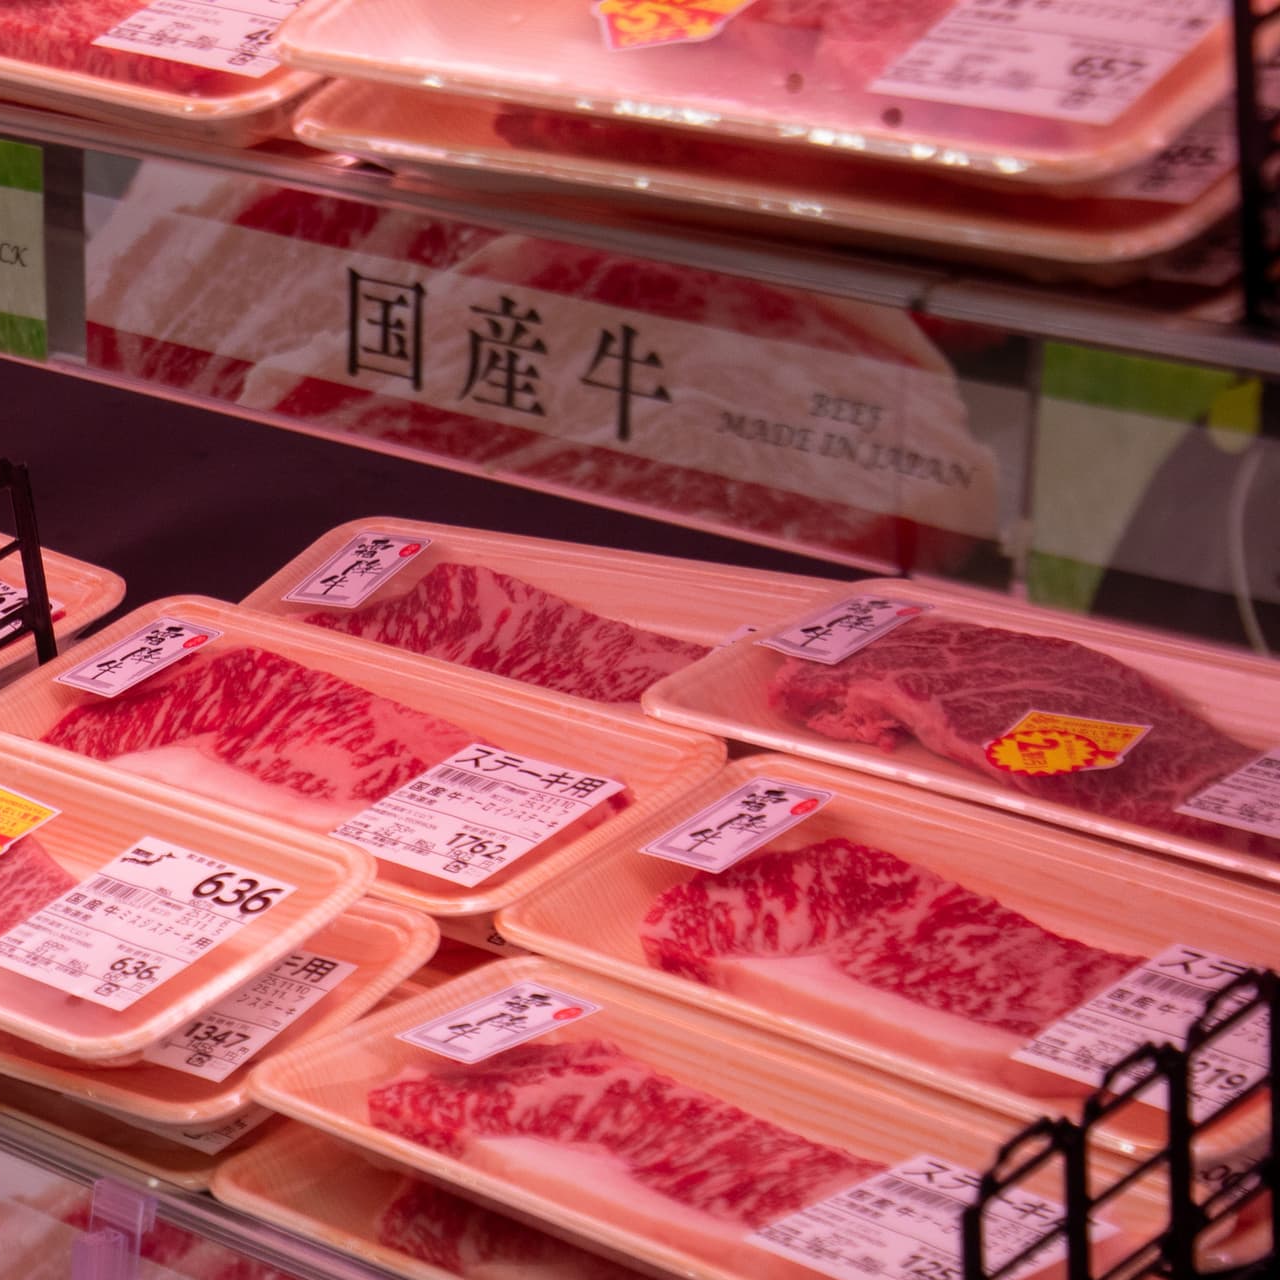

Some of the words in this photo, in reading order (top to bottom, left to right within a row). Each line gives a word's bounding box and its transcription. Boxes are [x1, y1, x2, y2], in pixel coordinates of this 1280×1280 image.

[347, 266, 672, 442] 国産牛
[811, 392, 885, 431] BEEF
[717, 409, 808, 453] MADE
[822, 427, 856, 459] IN
[861, 434, 977, 491] JAPAN
[454, 748, 608, 800] ステーキ用
[446, 832, 507, 859] 1762
[192, 872, 285, 914] 636
[110, 957, 162, 980] 636
[184, 1022, 251, 1049] 1347
